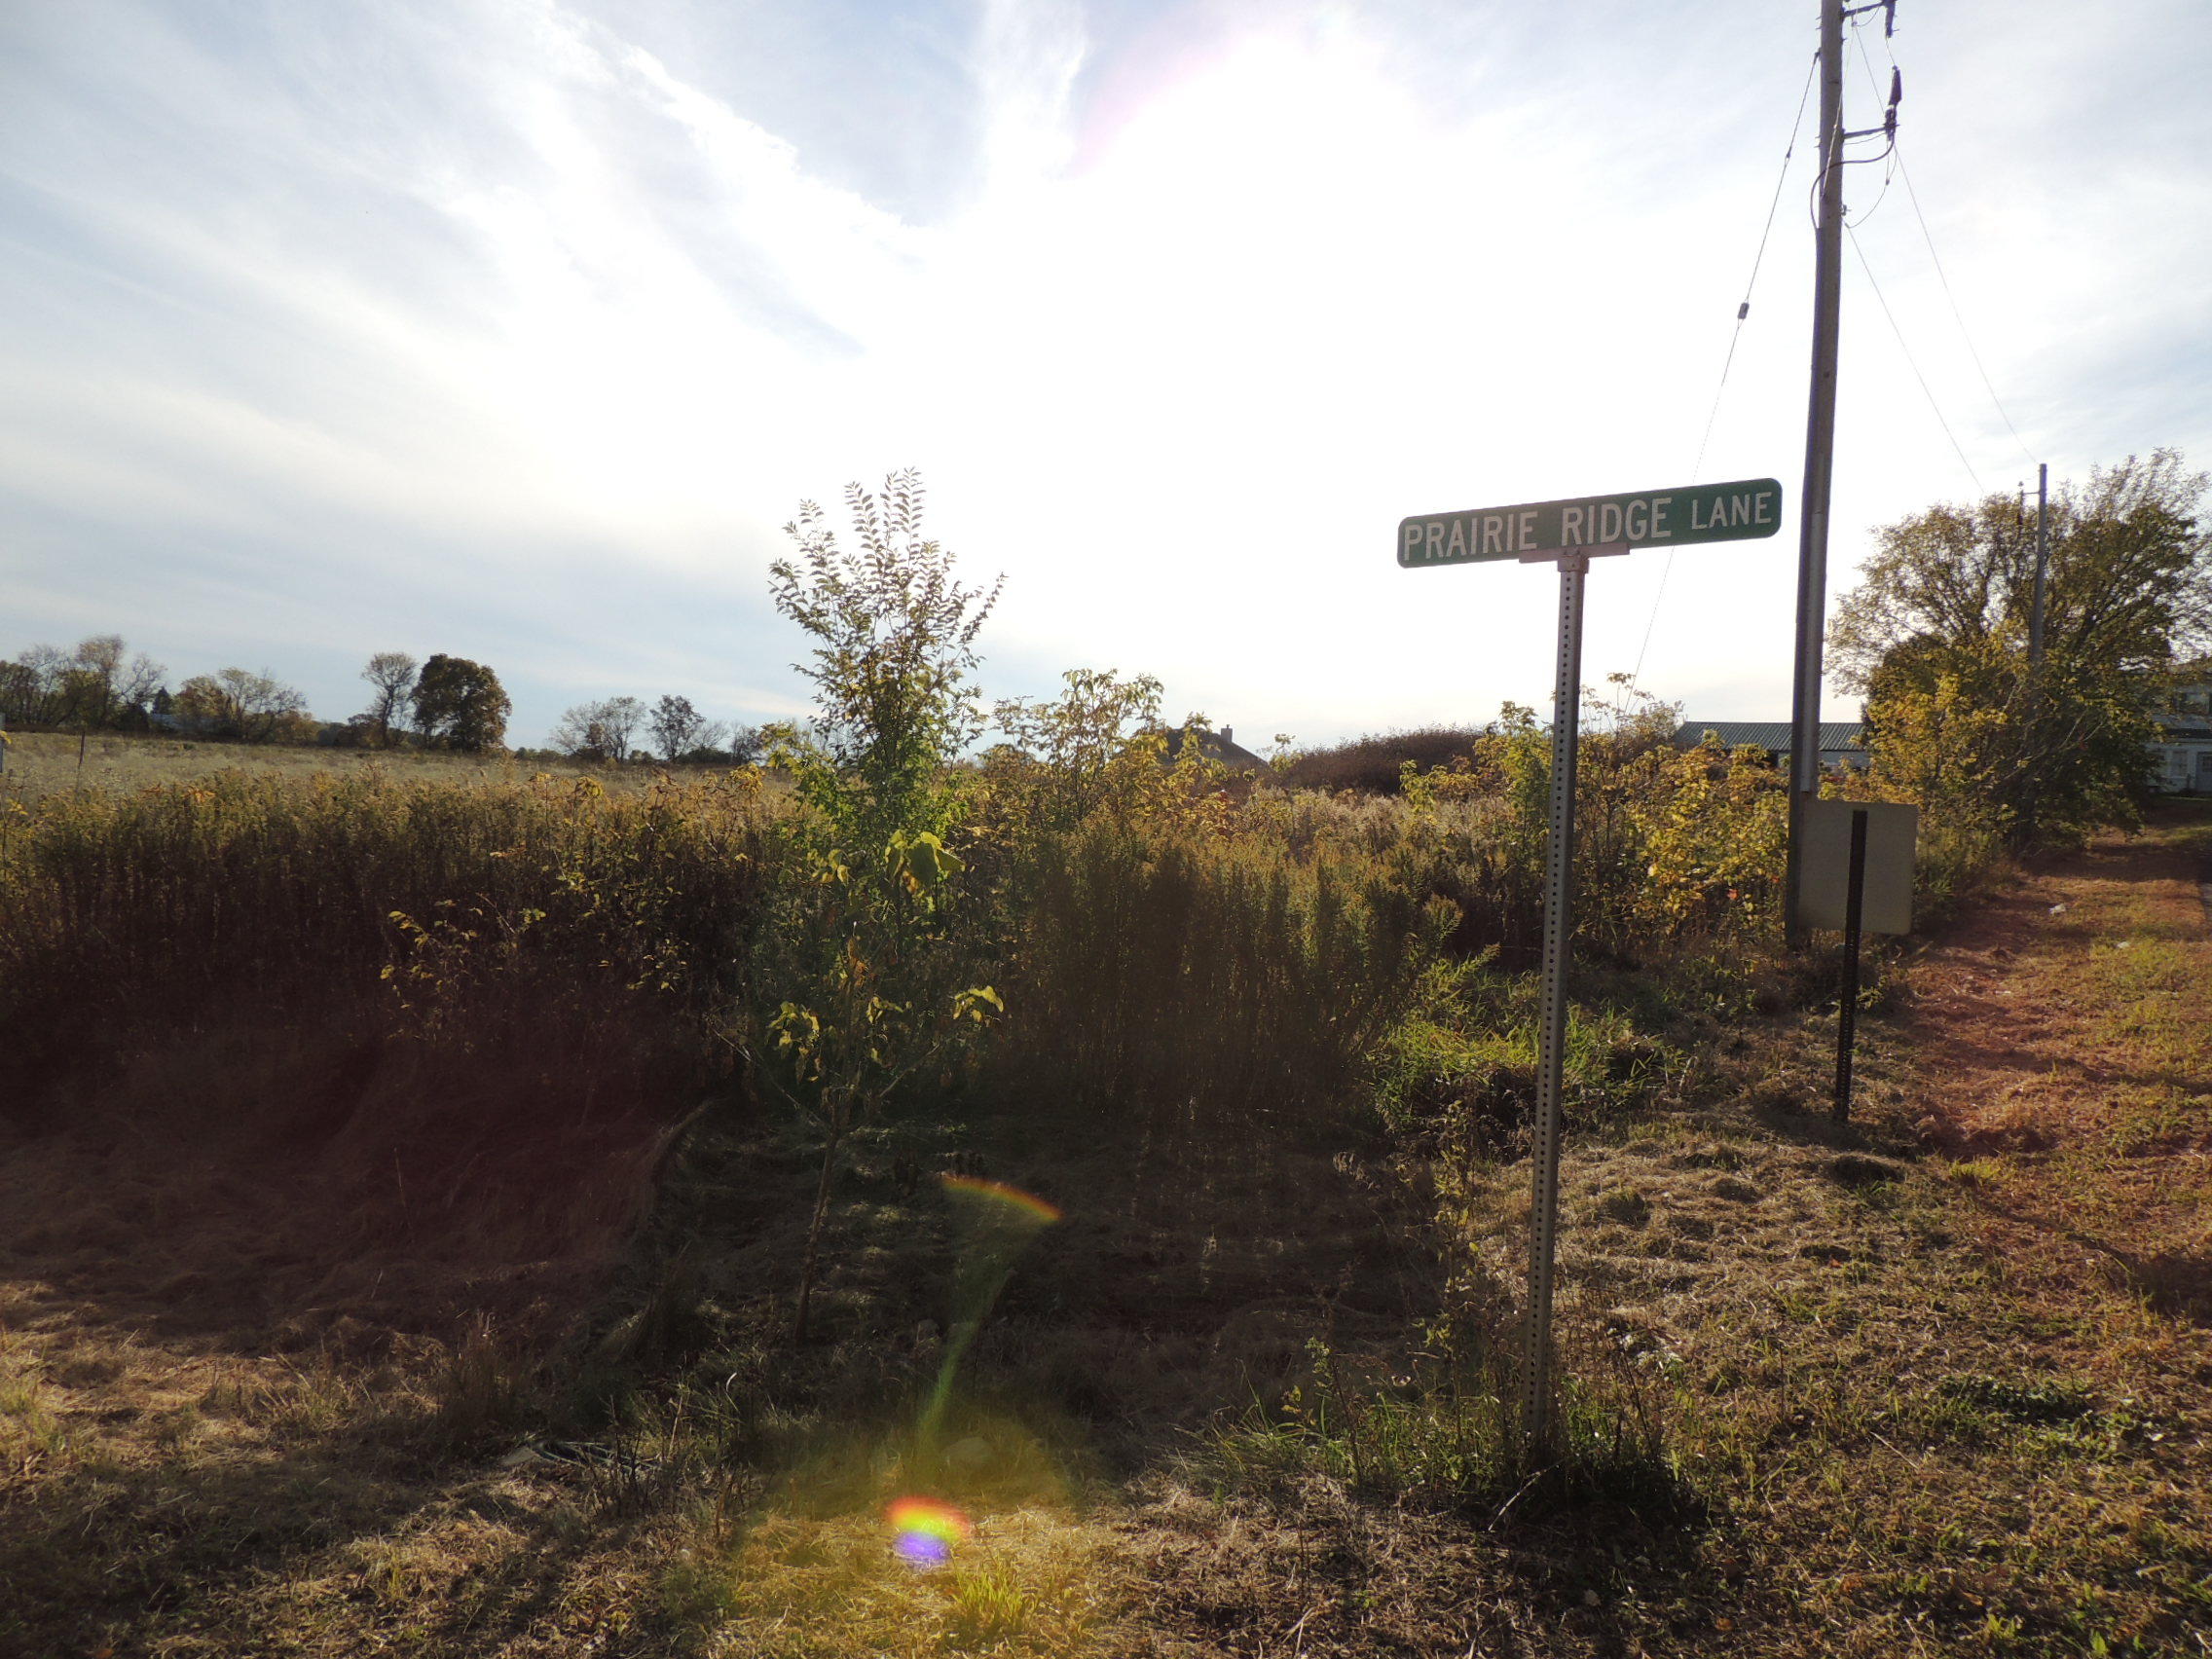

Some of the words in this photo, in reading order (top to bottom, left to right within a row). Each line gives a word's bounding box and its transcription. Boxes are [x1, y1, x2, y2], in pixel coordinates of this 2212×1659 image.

[1404, 511, 1538, 561] PRAIRIE
[1561, 498, 1672, 546] RIDGE
[1691, 492, 1772, 530] LANE
